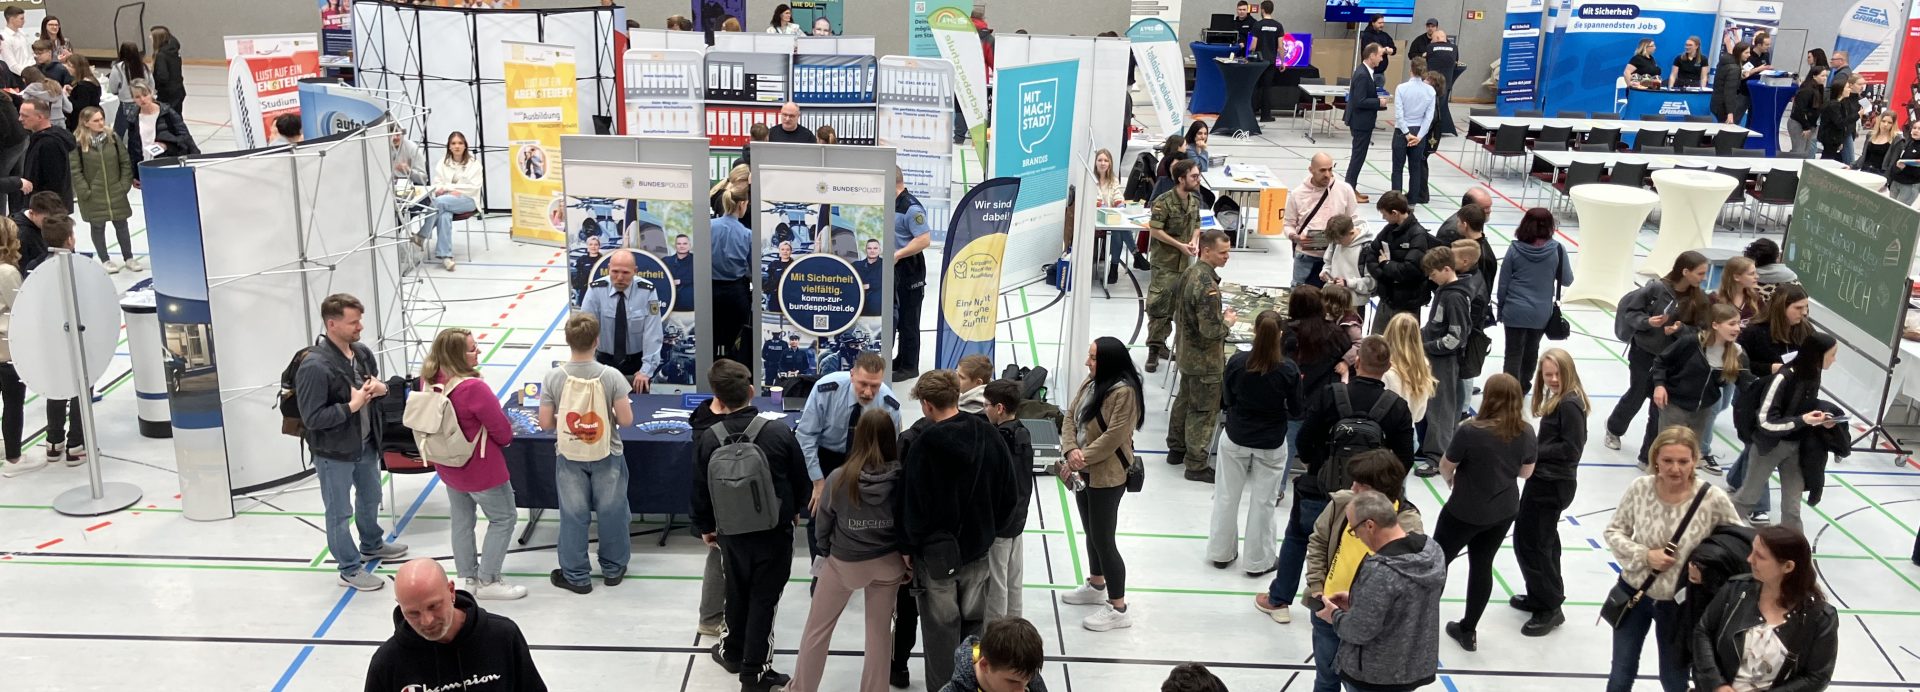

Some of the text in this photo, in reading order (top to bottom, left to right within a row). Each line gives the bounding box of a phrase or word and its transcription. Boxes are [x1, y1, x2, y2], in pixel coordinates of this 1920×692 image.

[1594, 7, 1633, 16] Sicherheit
[1584, 22, 1635, 30] spannendsten
[1637, 22, 1658, 30] Jobs
[255, 64, 303, 82] LUST AUF EIN
[1023, 90, 1041, 104] MIT
[261, 97, 298, 110] Studium
[1022, 114, 1051, 130] STADT
[1022, 154, 1048, 167] BRANDIS
[638, 181, 689, 189] BUNDESPOLIZEI
[832, 185, 882, 194] BUNDESPOLIZEI
[974, 200, 1012, 209] Wir sind
[982, 212, 1011, 222] dabei!
[790, 273, 854, 284] Mit Sicherheit
[801, 285, 843, 296] vielfältig.
[1838, 270, 1871, 315] EUCH
[801, 294, 843, 303] komm-zur-
[789, 302, 855, 312] bundespolizei.de
[848, 518, 894, 527] DRECHSE
